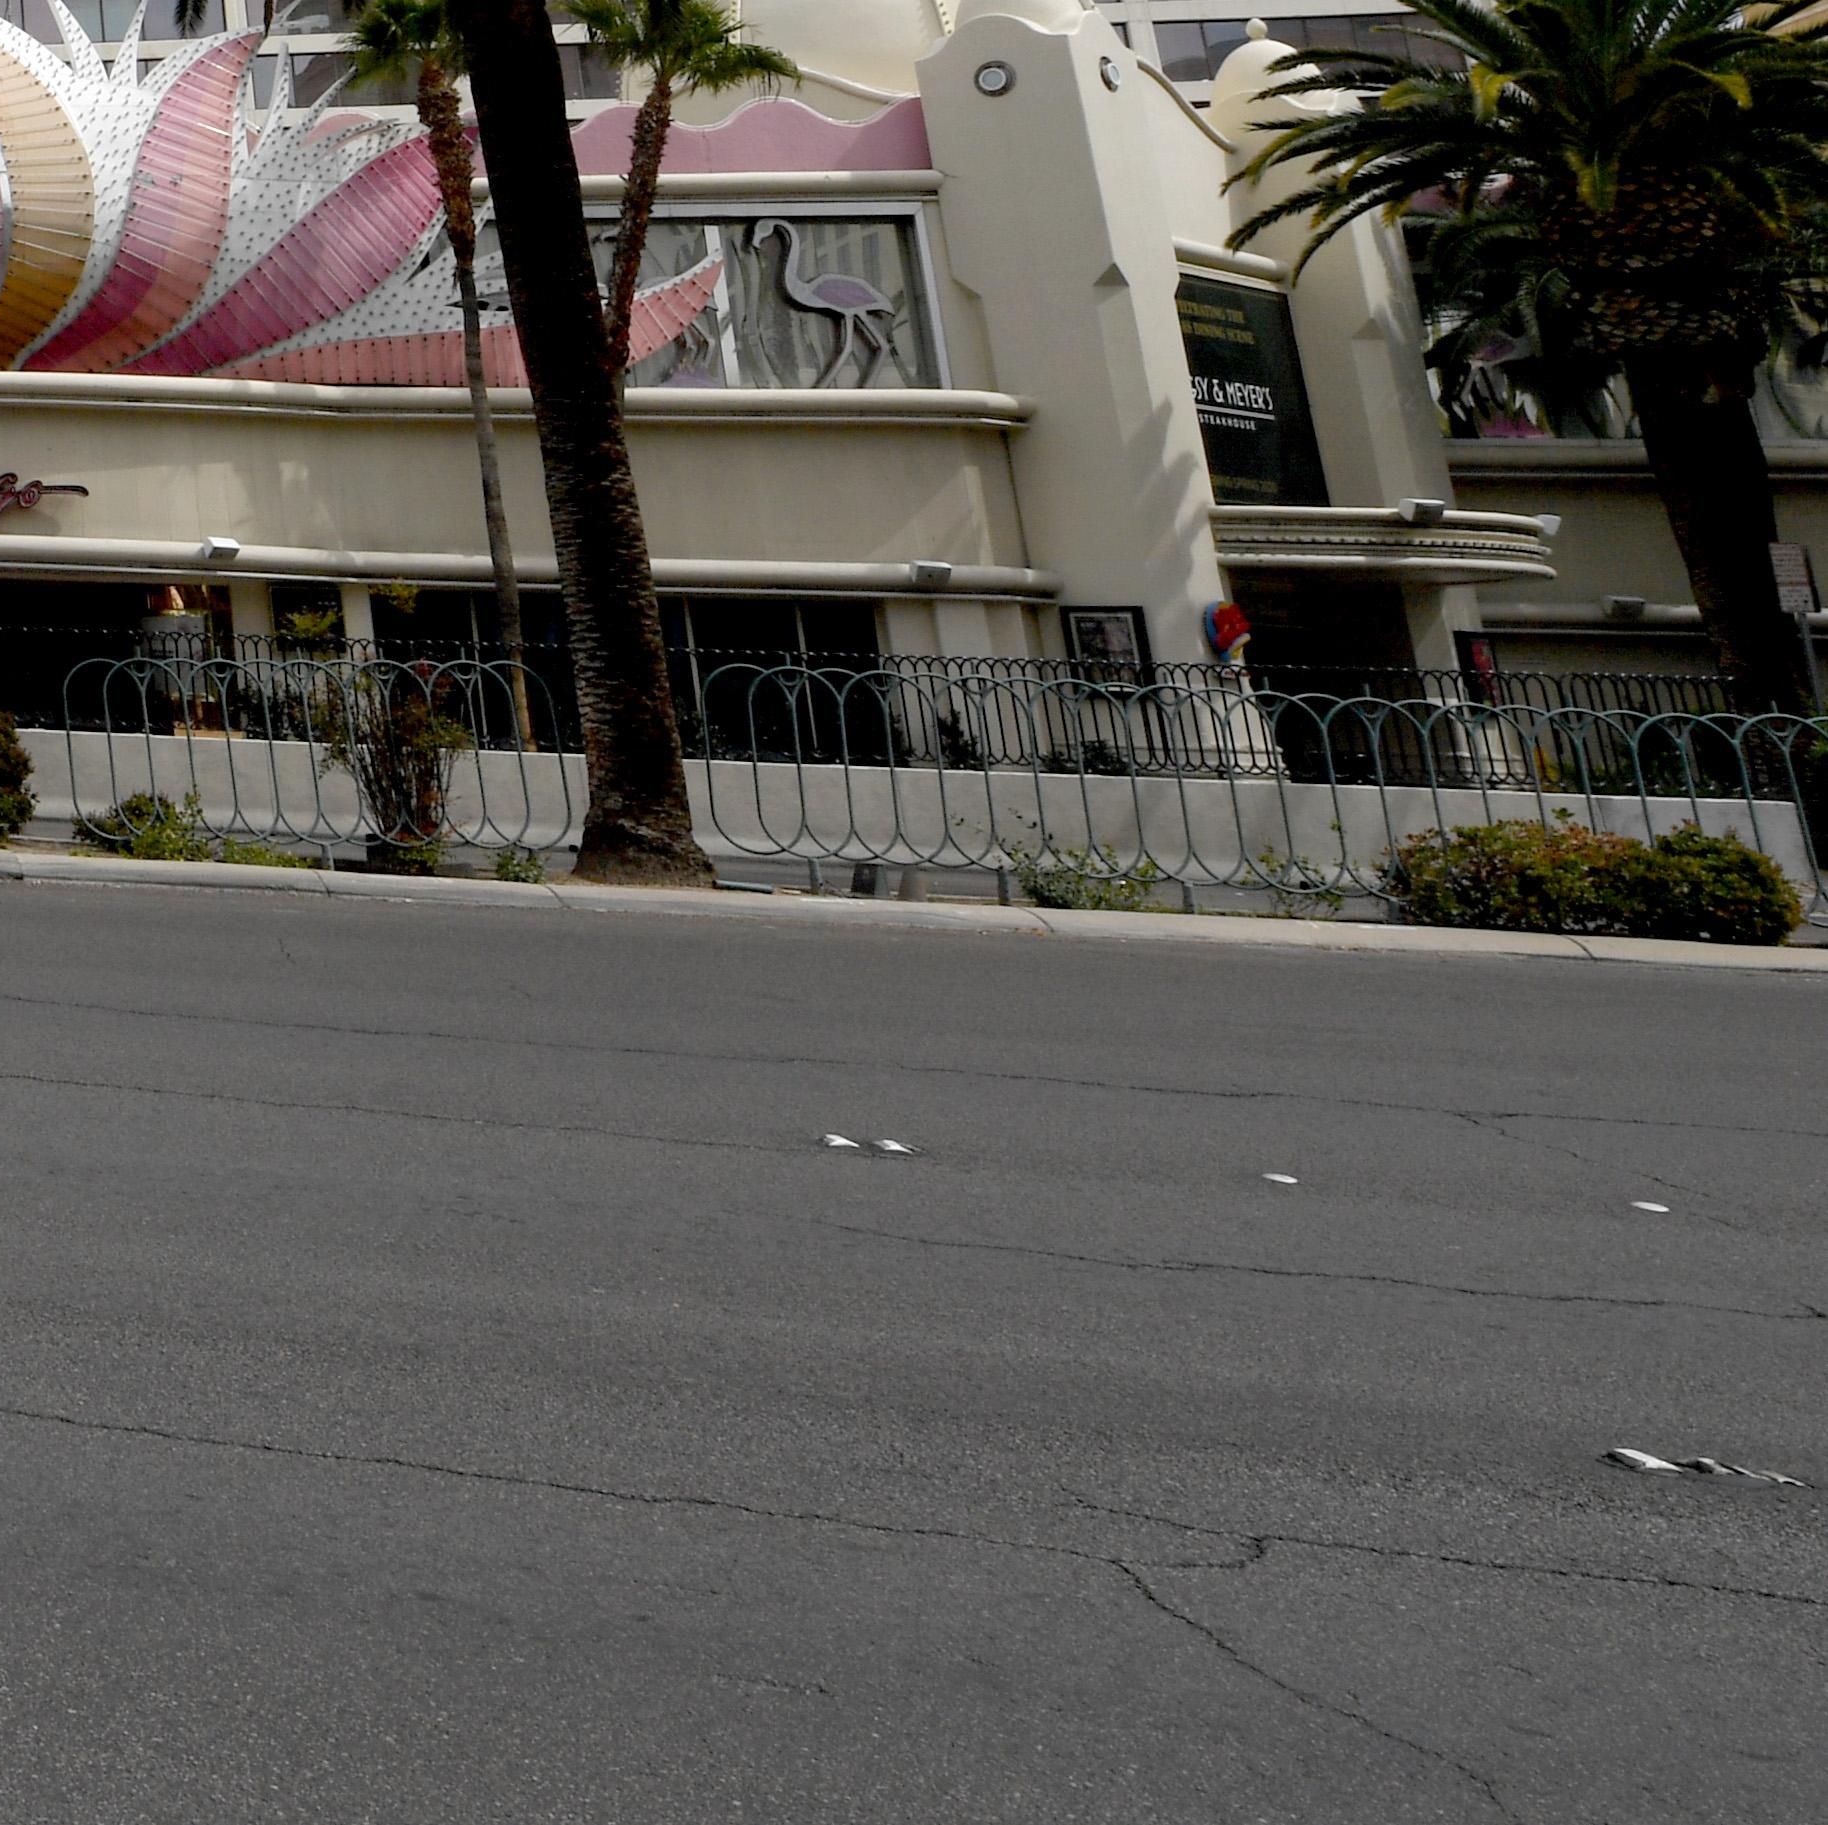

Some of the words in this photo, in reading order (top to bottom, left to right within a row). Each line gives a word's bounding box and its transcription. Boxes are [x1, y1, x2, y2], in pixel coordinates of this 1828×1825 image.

[1211, 379, 1225, 404] &
[1224, 381, 1274, 412] MEYER'S
[1198, 412, 1257, 432] STEAKHOUSE
